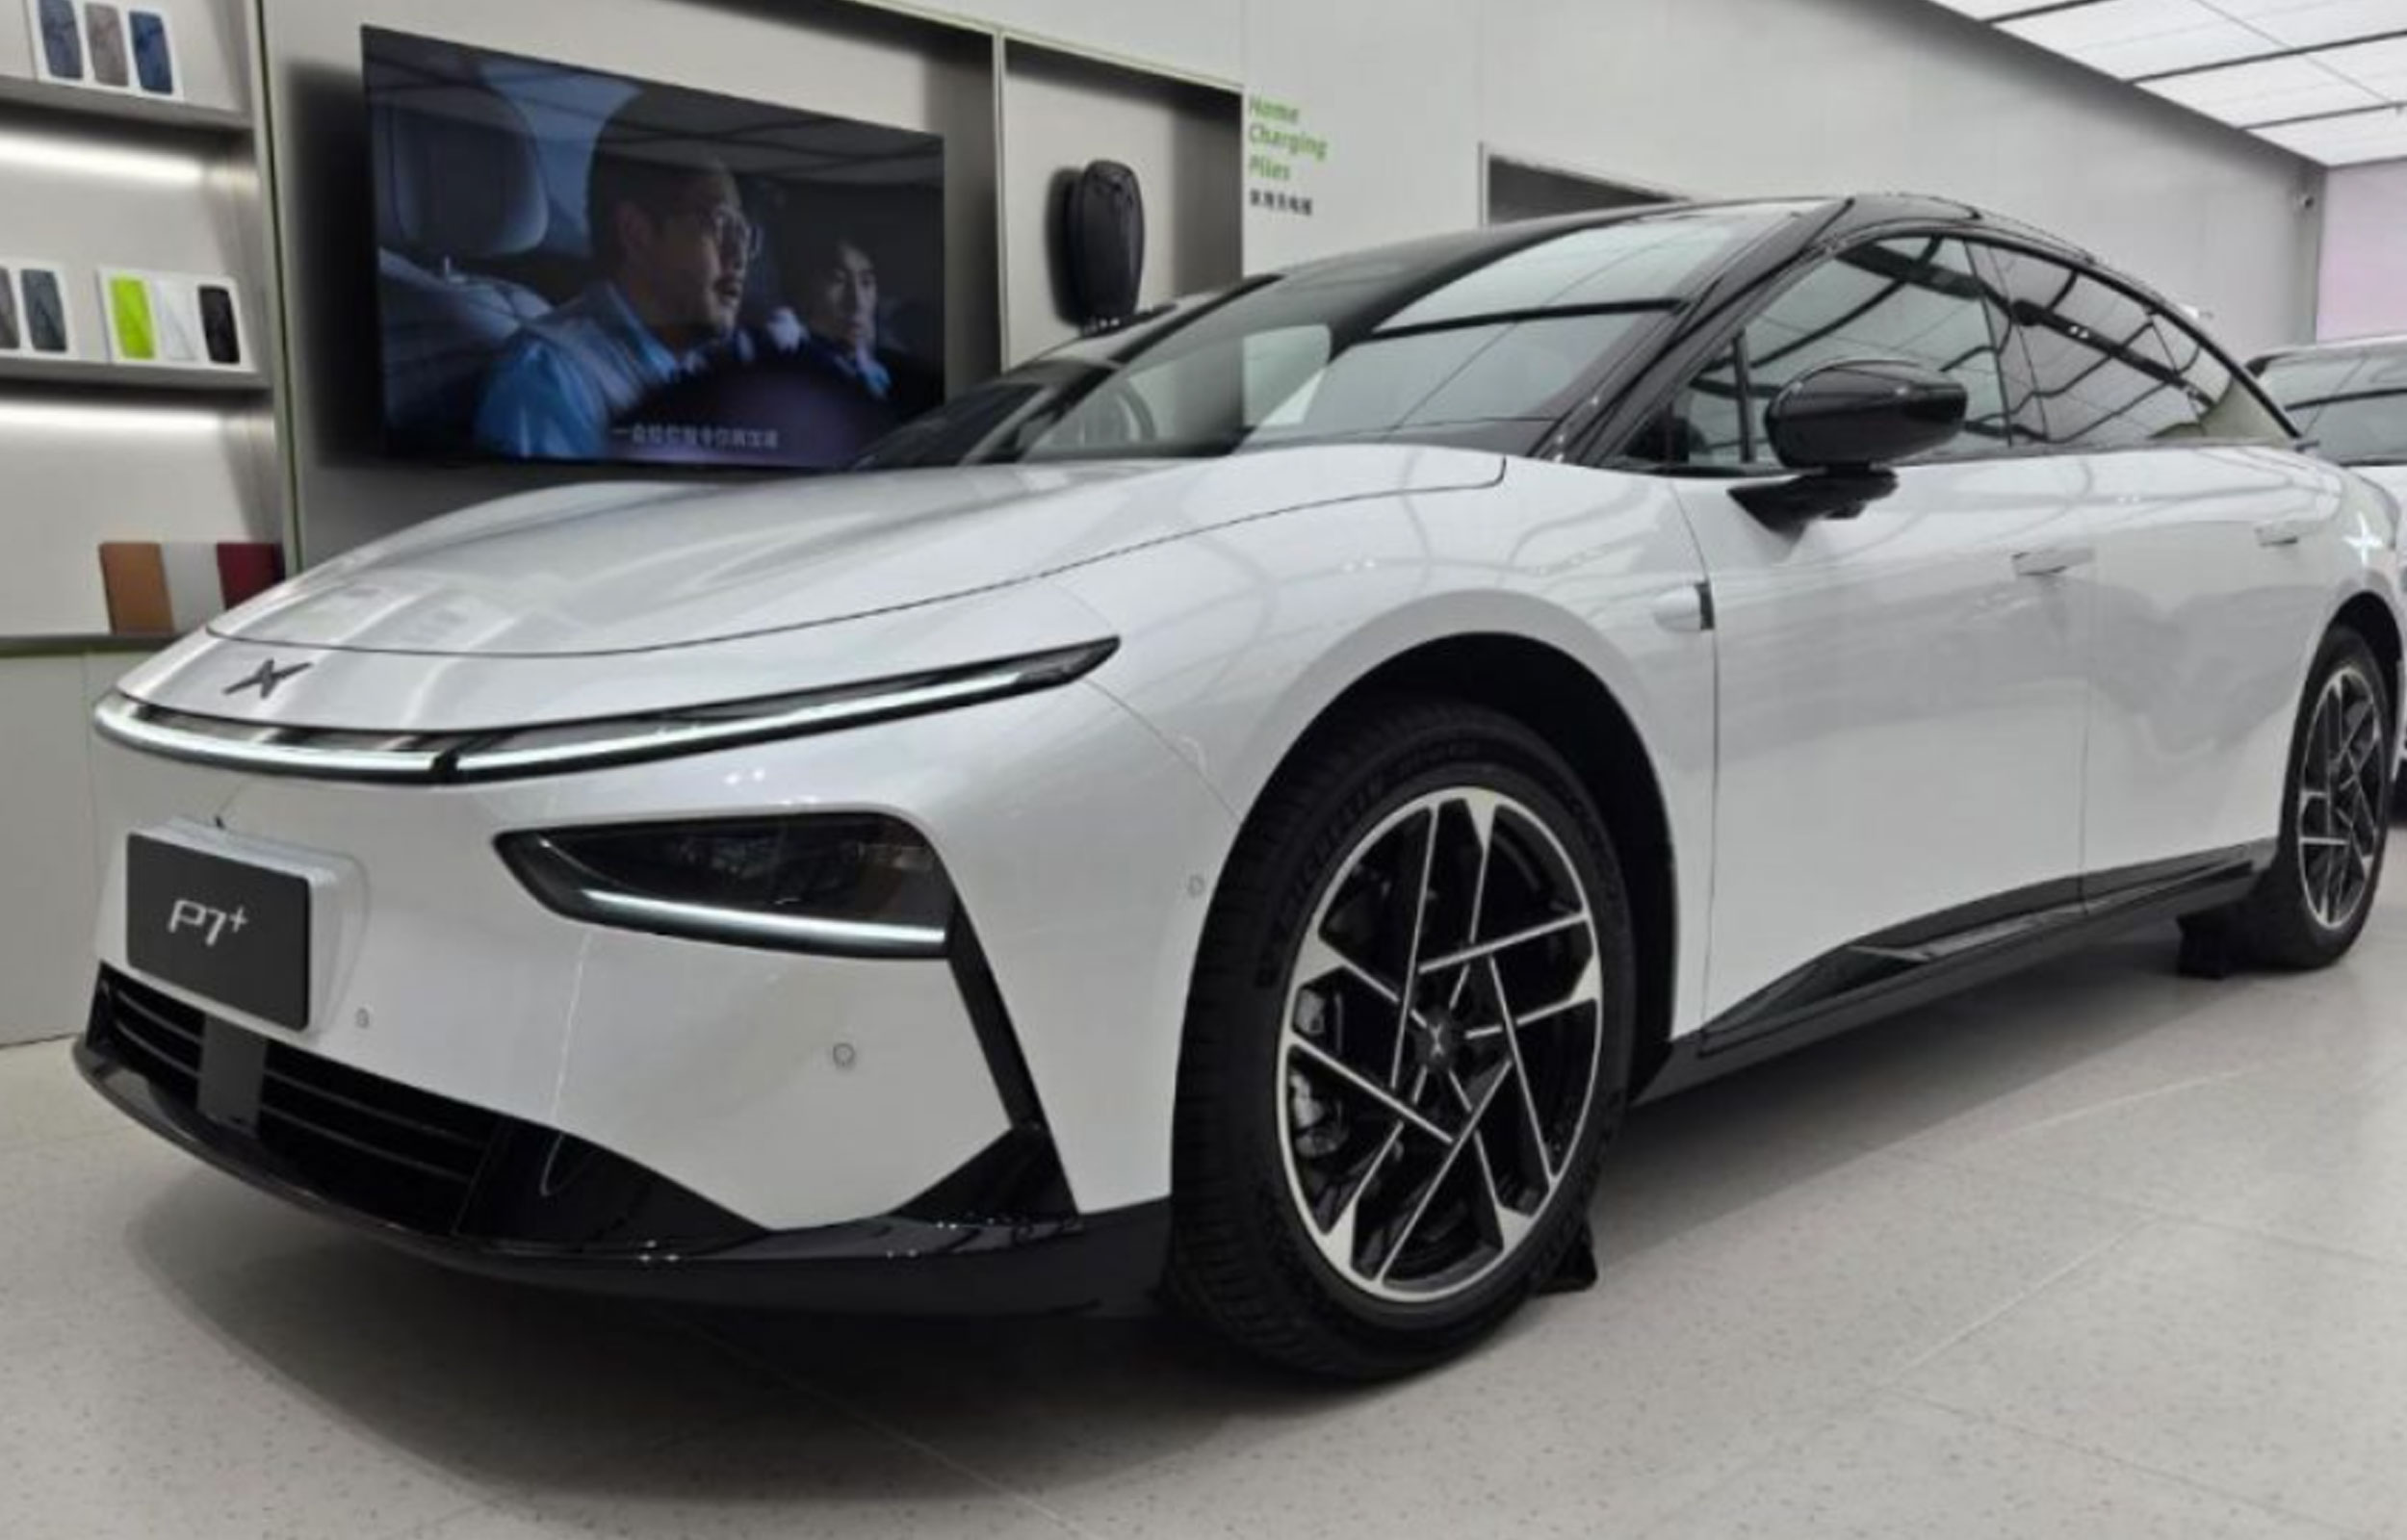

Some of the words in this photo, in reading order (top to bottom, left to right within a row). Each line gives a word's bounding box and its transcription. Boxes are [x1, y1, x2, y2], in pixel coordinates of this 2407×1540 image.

[1250, 97, 1299, 122] Home
[1249, 123, 1328, 161] Charging
[1250, 154, 1291, 180] Piles
[168, 899, 247, 946] P7+
